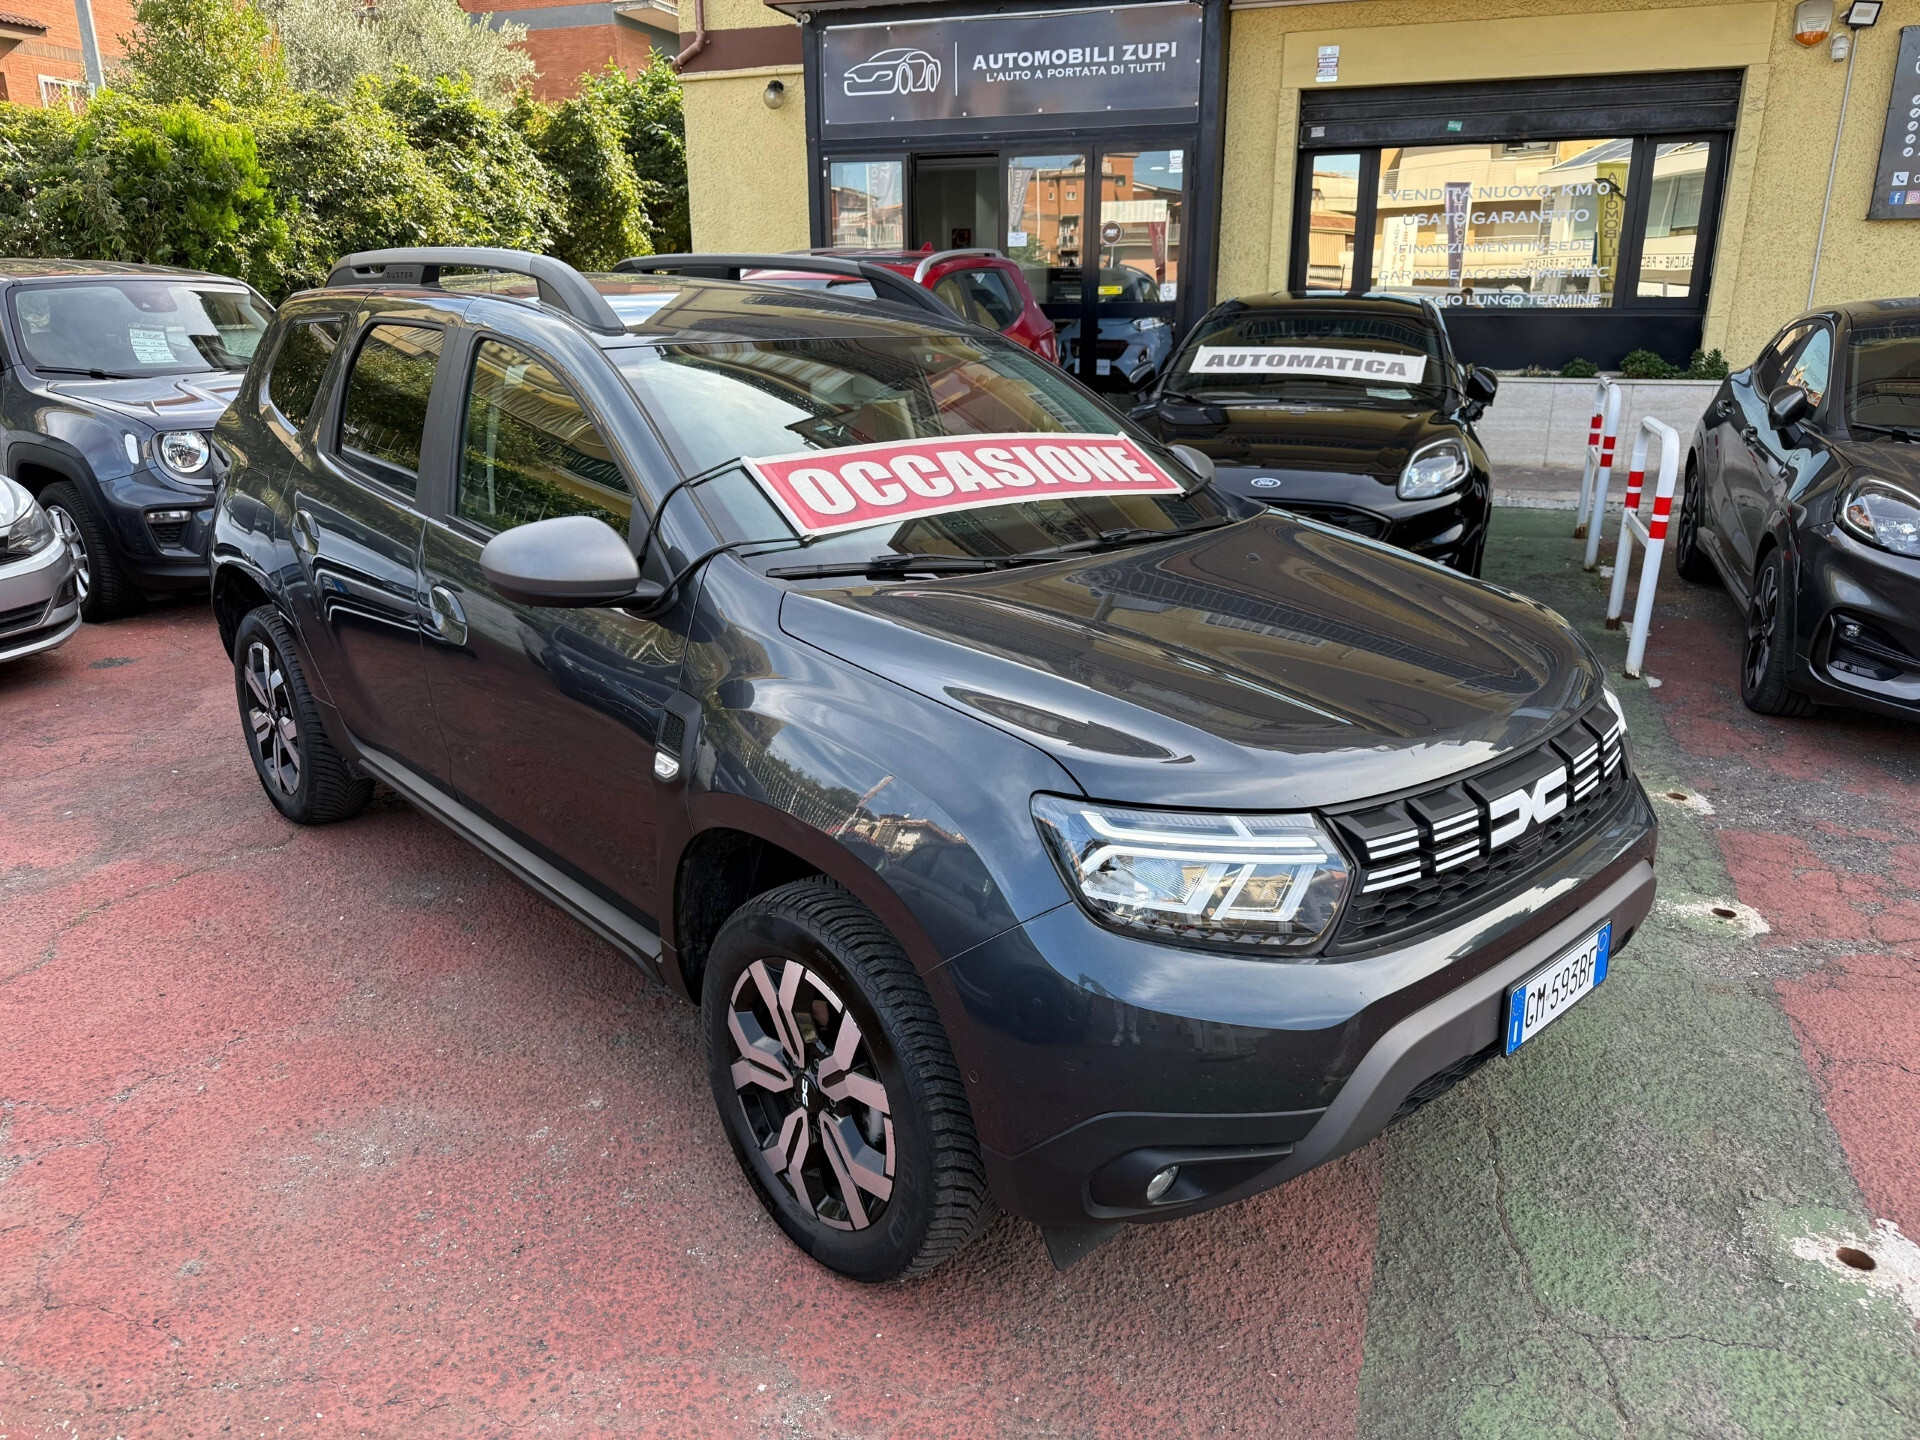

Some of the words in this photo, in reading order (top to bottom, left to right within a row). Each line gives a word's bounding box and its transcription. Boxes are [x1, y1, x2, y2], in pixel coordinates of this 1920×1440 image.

[973, 46, 1115, 70] AUTOMOBILI
[1122, 42, 1178, 61] ZUPI
[986, 70, 1031, 83] L'AUTO
[1035, 69, 1044, 79] A
[1047, 66, 1107, 78] PORTATA
[1111, 64, 1124, 75] DI
[1128, 61, 1166, 73] TUTTI
[1389, 187, 1473, 201] VENDITA
[1561, 183, 1592, 197] KM
[1597, 181, 1611, 196] 0
[1403, 212, 1467, 226] USATO
[1472, 209, 1590, 225] GARANTITO
[1549, 240, 1592, 252] SEDE
[1379, 269, 1460, 280] GARANZIE
[1464, 267, 1568, 280] ACCESSORIE
[1571, 266, 1610, 279] MEC
[1466, 294, 1523, 307] LUNGO
[1527, 293, 1602, 306] TERMINE
[1204, 354, 1407, 376] AUTOMATICA
[787, 446, 1158, 516] OCCASIONE
